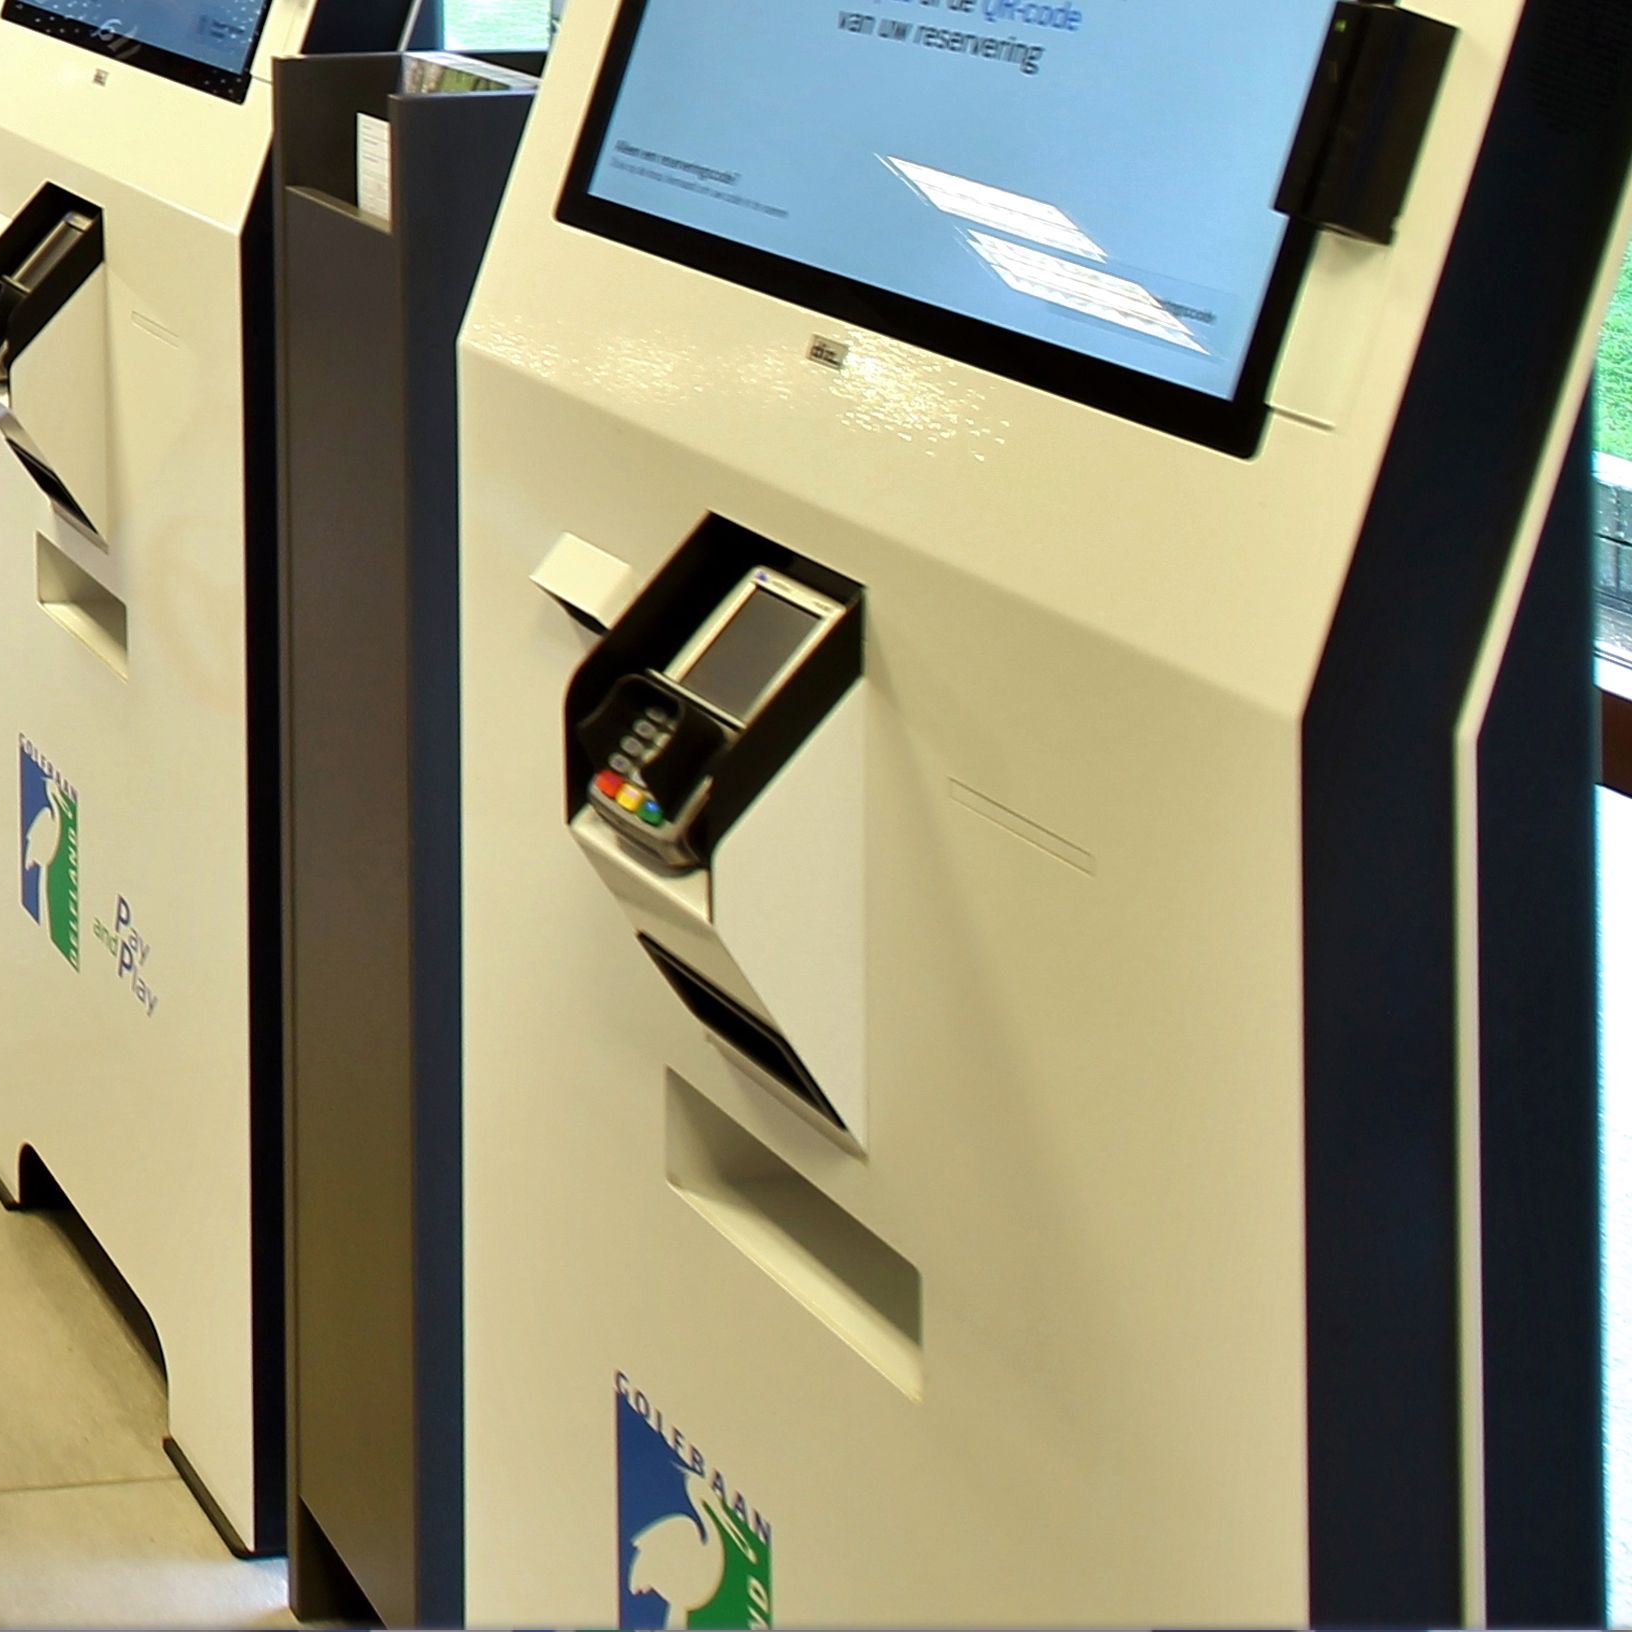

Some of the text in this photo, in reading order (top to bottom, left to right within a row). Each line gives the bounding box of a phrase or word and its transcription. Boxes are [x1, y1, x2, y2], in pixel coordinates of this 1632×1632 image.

[838, 9, 1046, 76] van uw reservering
[92, 918, 119, 958] and
[114, 892, 151, 967] Pay
[117, 941, 159, 1019] Play
